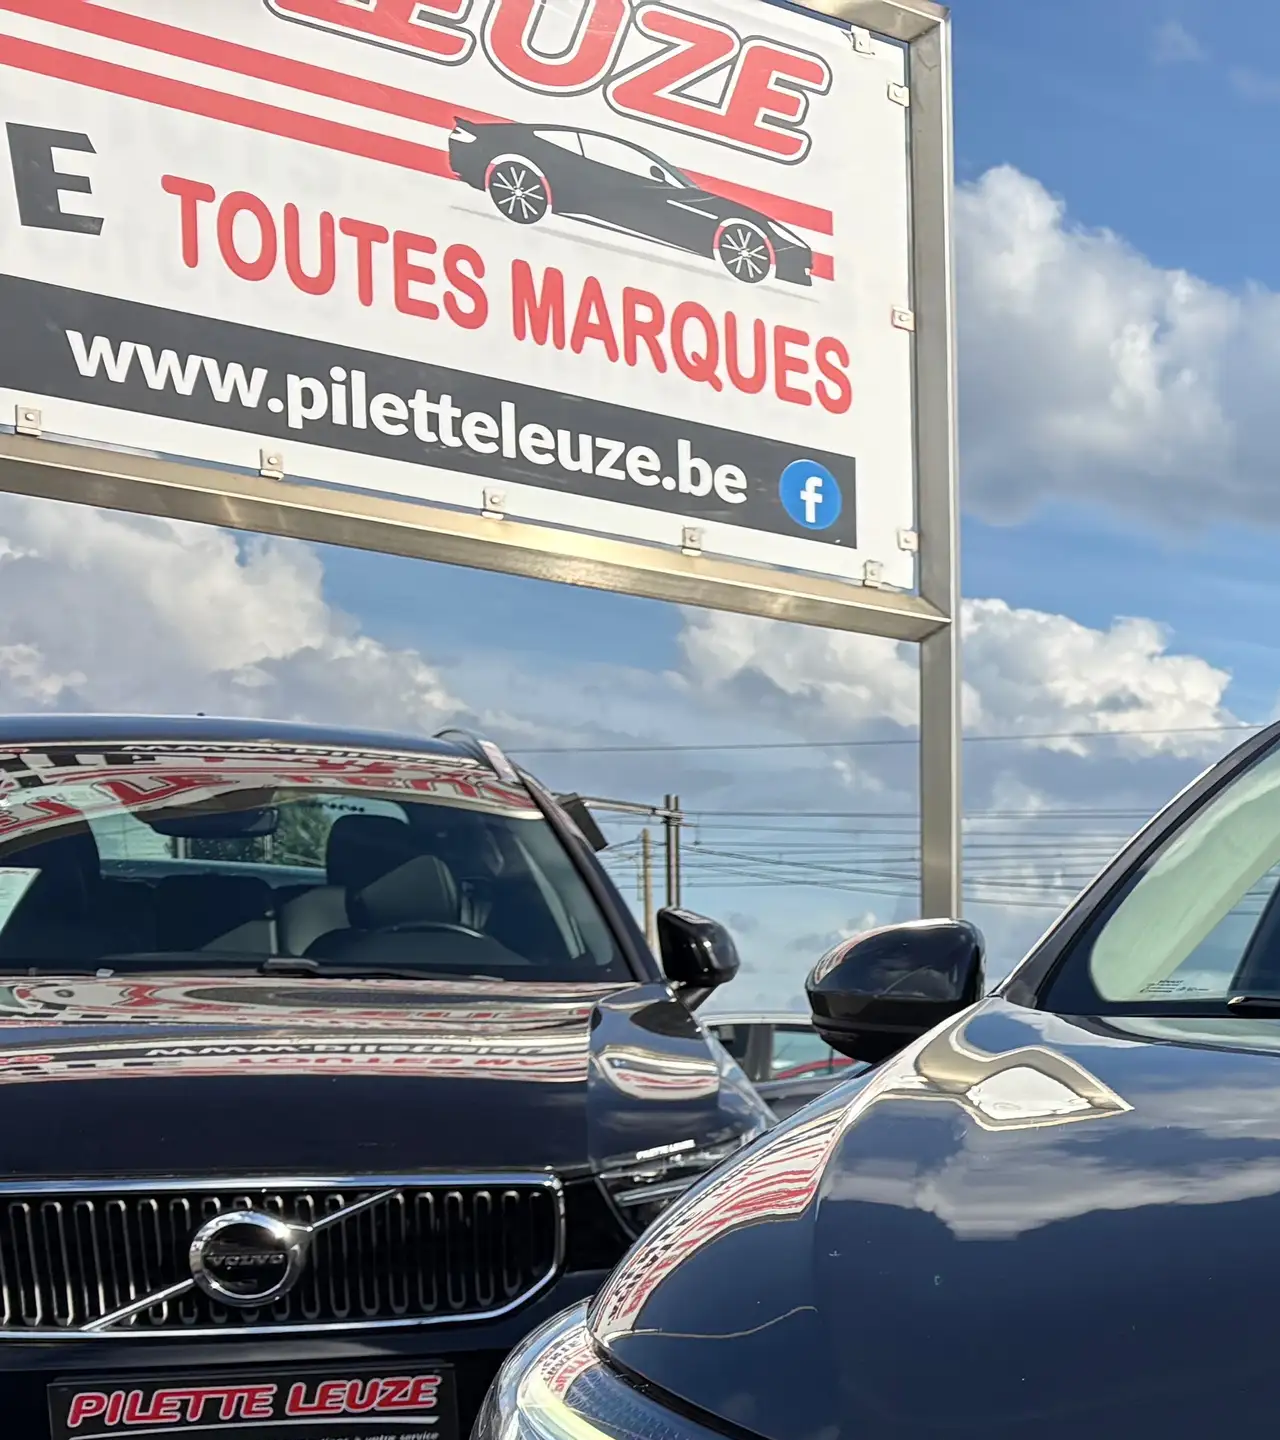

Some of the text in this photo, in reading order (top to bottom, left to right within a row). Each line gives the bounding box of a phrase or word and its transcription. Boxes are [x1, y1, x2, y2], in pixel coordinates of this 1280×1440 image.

[267, 0, 832, 165] EUZE
[161, 174, 853, 415] TOUTES MARQUES
[65, 329, 749, 506] www.piletteleuze.be
[206, 1253, 284, 1266] VOLVO
[67, 1375, 442, 1428] PILETTE LEUZE
